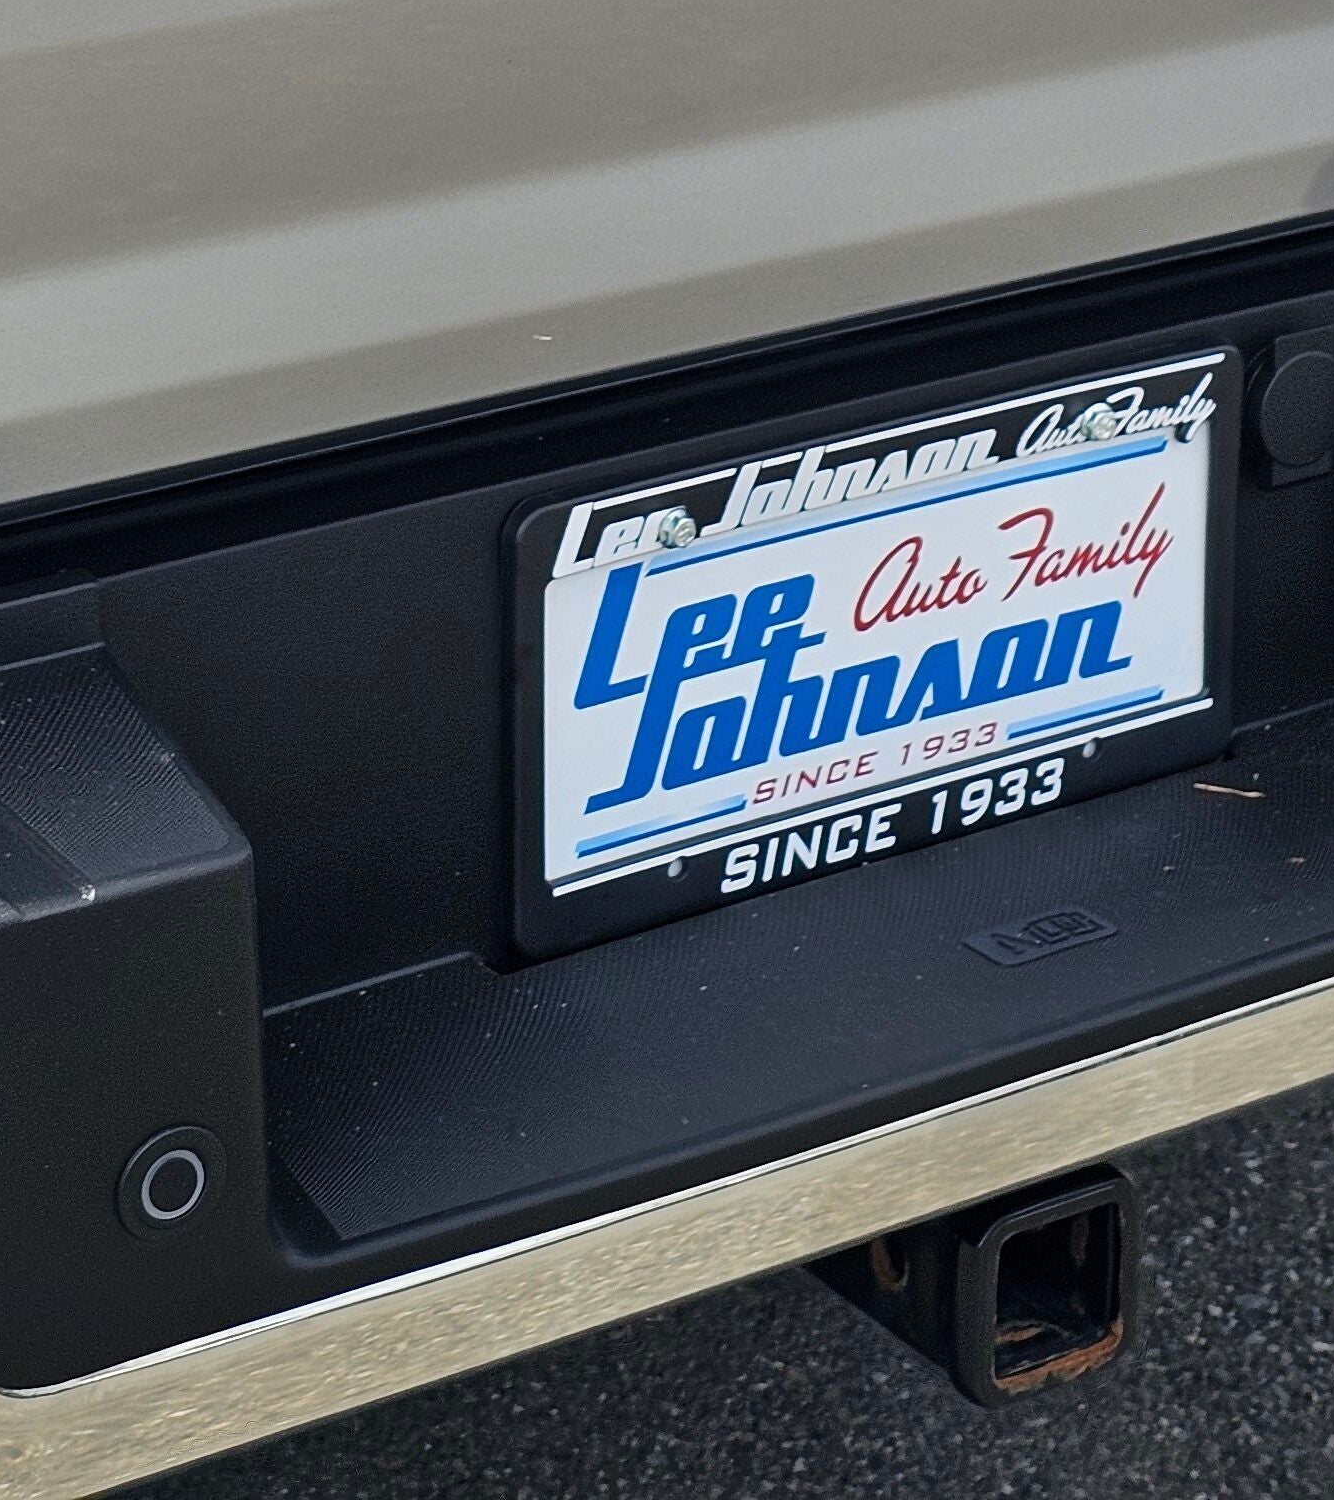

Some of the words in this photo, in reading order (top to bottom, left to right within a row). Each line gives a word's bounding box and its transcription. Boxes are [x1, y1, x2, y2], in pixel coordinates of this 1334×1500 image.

[699, 427, 1000, 538] Johnson
[1016, 403, 1103, 459] Aut
[1103, 372, 1217, 442] Family
[854, 536, 987, 633] Auto
[999, 482, 1173, 599] Family
[573, 560, 817, 710] Lee
[583, 600, 1133, 816] Johnson
[720, 803, 904, 897] SINCE
[929, 757, 1066, 836] 1933
[751, 750, 876, 807] SINCE
[899, 722, 999, 768] 1933
